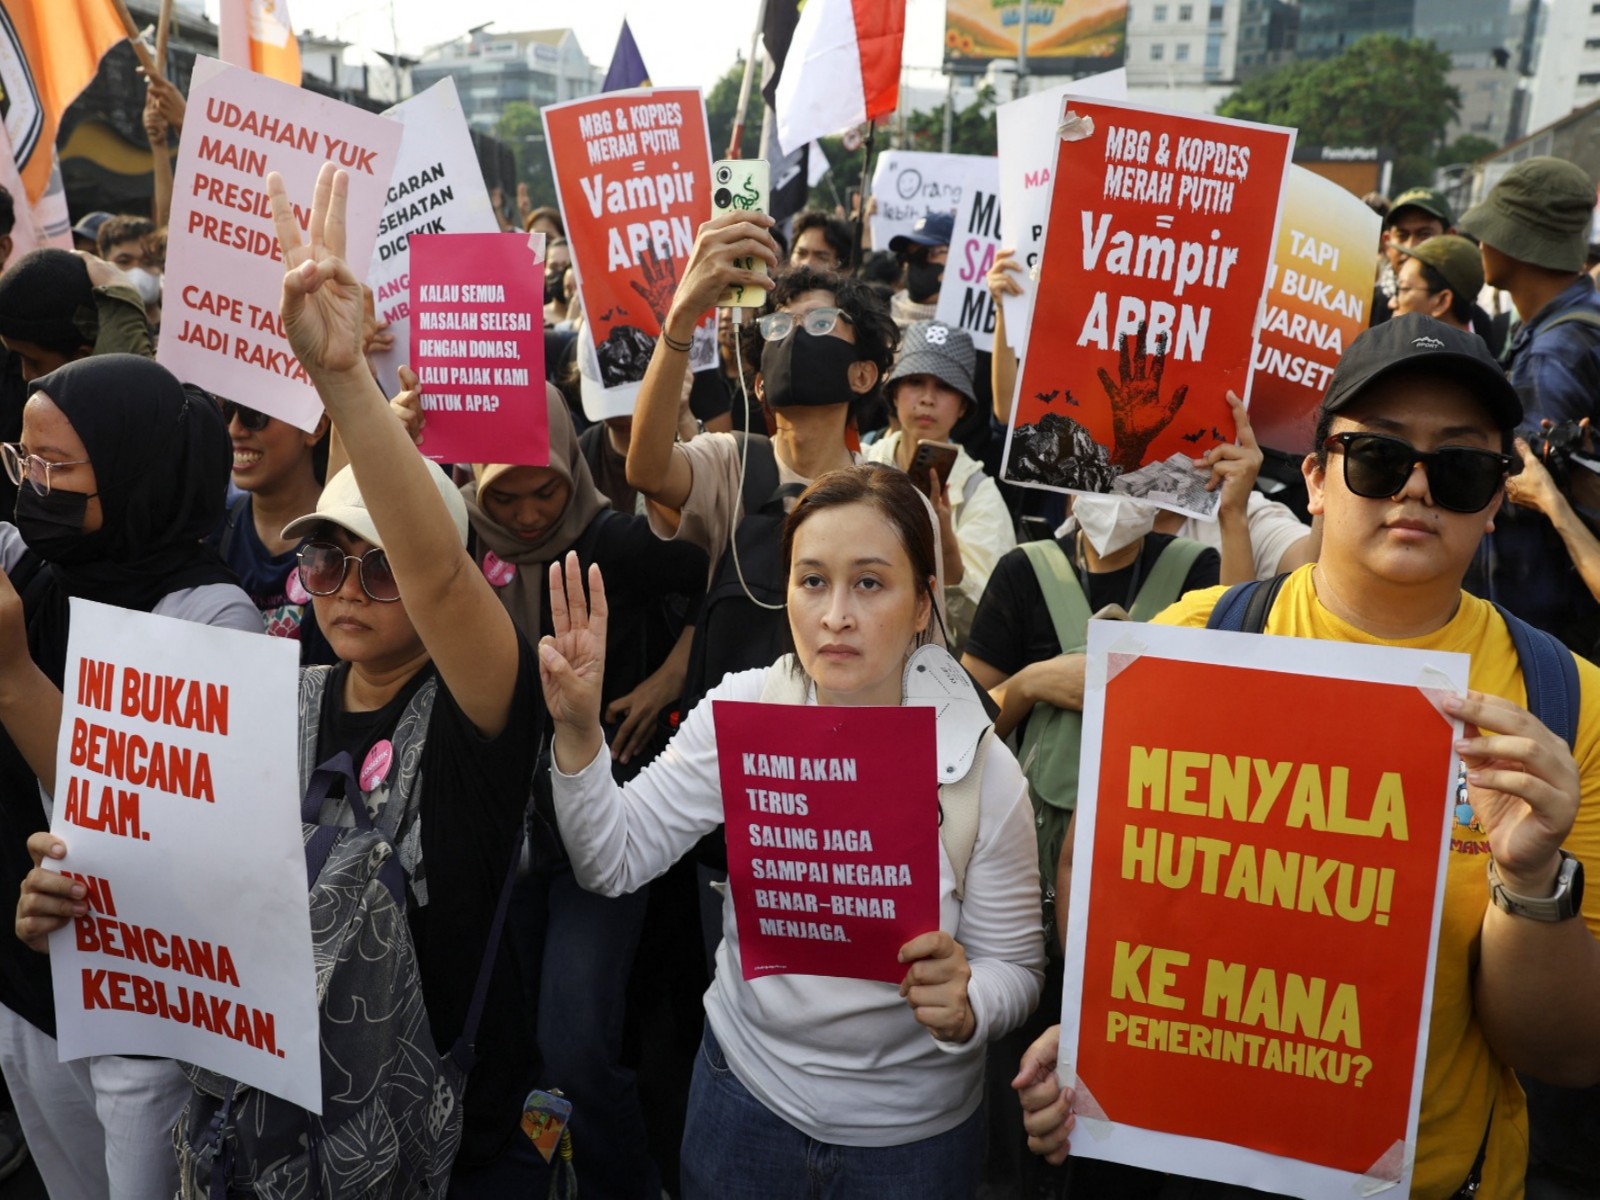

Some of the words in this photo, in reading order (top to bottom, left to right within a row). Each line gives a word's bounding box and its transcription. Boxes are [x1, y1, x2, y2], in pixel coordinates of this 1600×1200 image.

[206, 97, 319, 154] UDAHAN
[323, 134, 378, 175] YUK
[578, 110, 613, 141] MBG
[615, 108, 628, 131] &
[629, 102, 683, 128] KOPDES
[586, 133, 638, 167] MERAH
[640, 128, 680, 155] PUTIH
[198, 135, 267, 177] MAIN
[1105, 126, 1151, 165] MBG
[1155, 132, 1171, 168] &
[1175, 136, 1251, 183] KOPDES
[192, 173, 311, 231] PRESIDN
[384, 162, 446, 206] GARAN
[579, 161, 695, 218] Vampir
[1103, 164, 1174, 204] MERAH
[1177, 175, 1235, 215] PUTIH
[188, 210, 285, 263] PRESIDE
[376, 185, 455, 237] SEHATAN
[608, 216, 694, 272] APBN
[1081, 210, 1239, 296] Vampir
[1291, 229, 1339, 272] TAPI
[182, 285, 243, 324] CAPE
[419, 285, 459, 303] KALAU
[461, 285, 505, 303] SEMUA
[1281, 268, 1363, 324] BUKAN
[419, 312, 478, 331] MASALAH
[480, 313, 531, 331] SELESAI
[1076, 291, 1211, 362] APBN
[178, 320, 229, 355] JADI
[234, 337, 315, 387] RAKYA
[418, 339, 467, 357] DENGAN
[469, 340, 520, 360] DONASI,
[1254, 343, 1335, 391] UNSET
[418, 366, 448, 384] LALU
[451, 367, 491, 385] PAJAK
[494, 368, 529, 386] KAMI
[420, 394, 463, 411] UNTUK
[465, 395, 499, 412] APA?
[77, 657, 114, 712] INI
[121, 667, 228, 736] BUKAN
[70, 717, 215, 803] BENCANA
[742, 752, 795, 780] KAMI
[800, 757, 857, 782] AKAN
[64, 776, 150, 841] ALAM.
[745, 788, 809, 816] TERUS
[1128, 745, 1409, 841] MENYALA
[748, 823, 819, 851] SALING
[822, 829, 873, 852] JAGA
[751, 858, 829, 883] SAMPAI
[832, 863, 912, 886] NEGARA
[1121, 825, 1396, 926] HUTANKU!
[754, 889, 896, 919] BENAR-BENAR
[759, 918, 852, 942] MENJAGA.
[75, 914, 240, 987] BENCANA
[81, 969, 285, 1058] KEBIJAKAN.
[1111, 941, 1190, 1010] KE
[1202, 959, 1362, 1049] MANA
[1106, 1011, 1373, 1088] PEMERINTAHKU?
